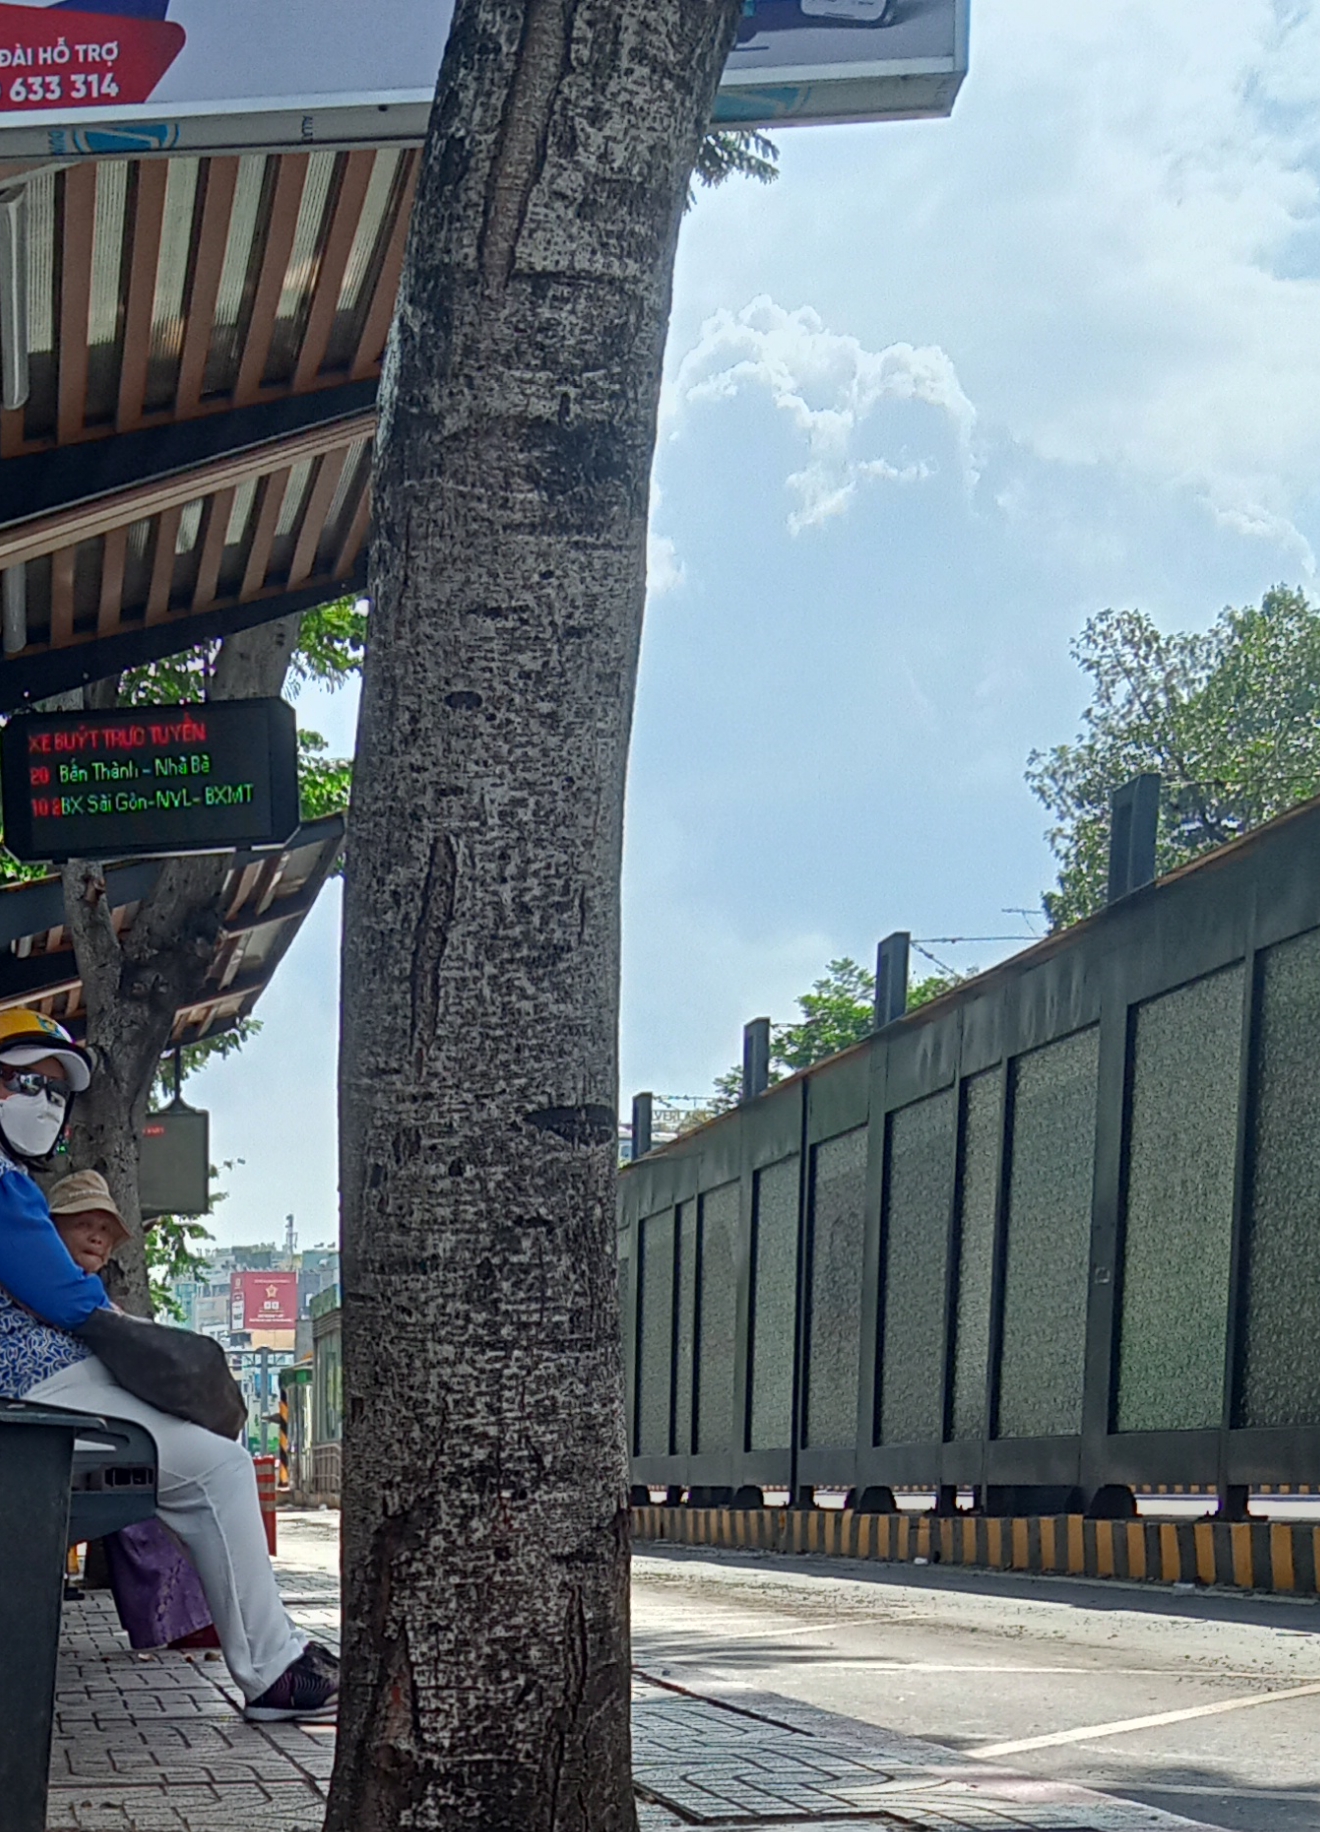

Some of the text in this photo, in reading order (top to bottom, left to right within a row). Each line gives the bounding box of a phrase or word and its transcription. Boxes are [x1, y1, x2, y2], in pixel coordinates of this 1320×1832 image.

[38, 37, 70, 65] HỖ
[75, 41, 120, 67] TRỢ
[9, 77, 62, 102] 633
[70, 73, 120, 99] 314
[29, 734, 51, 754] XE
[54, 724, 99, 751] BUÝT
[31, 766, 50, 786] 20
[59, 757, 88, 784] Bến
[91, 759, 139, 782] Thành
[155, 755, 188, 776] Nhà
[191, 754, 210, 774] Bè
[87, 794, 112, 813] Sài
[205, 783, 254, 806] BXMT
